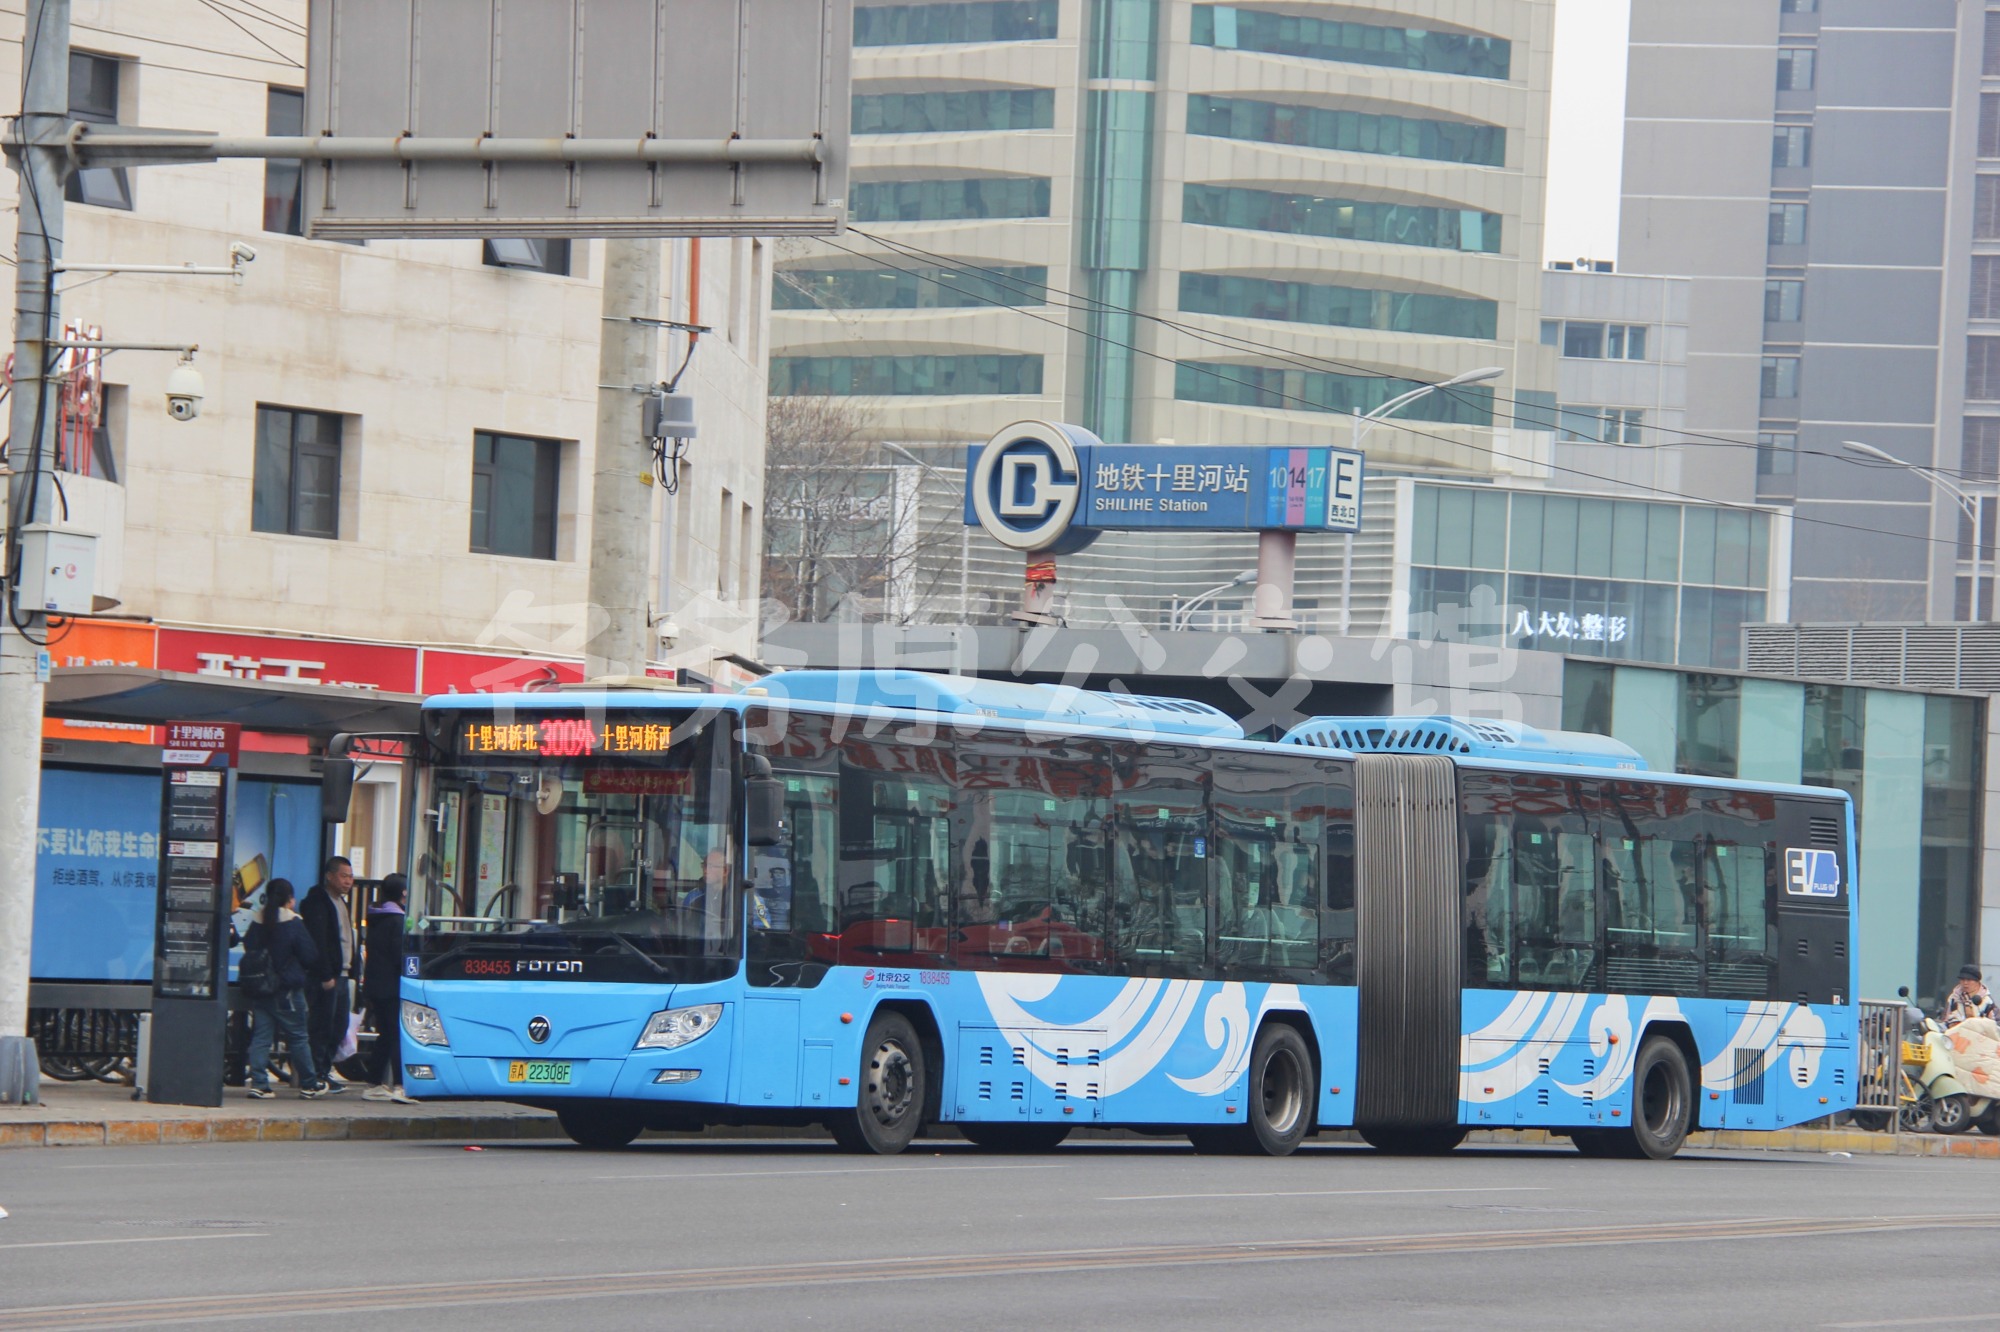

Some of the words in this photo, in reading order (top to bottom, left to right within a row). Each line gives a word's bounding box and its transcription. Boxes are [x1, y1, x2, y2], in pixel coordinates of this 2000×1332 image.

[1095, 462, 1249, 494] 地铁十里河站
[1270, 467, 1287, 488] 10
[1289, 467, 1306, 488] 14
[1307, 467, 1325, 488] 17
[1335, 458, 1353, 499] E
[1096, 497, 1153, 512] SHILIHE
[1159, 497, 1207, 512] Station
[1331, 504, 1356, 518] 西北口
[1512, 610, 1627, 643] 八大处整形
[170, 725, 225, 740] 十里河桥西
[464, 724, 537, 751] 十里河桥北
[539, 719, 596, 756] 300外
[600, 724, 671, 751] 十里河桥西
[37, 827, 160, 858] 不要让你我生命
[464, 960, 511, 974] 838455
[516, 960, 583, 973] FOTON
[877, 972, 911, 982] 北京公交
